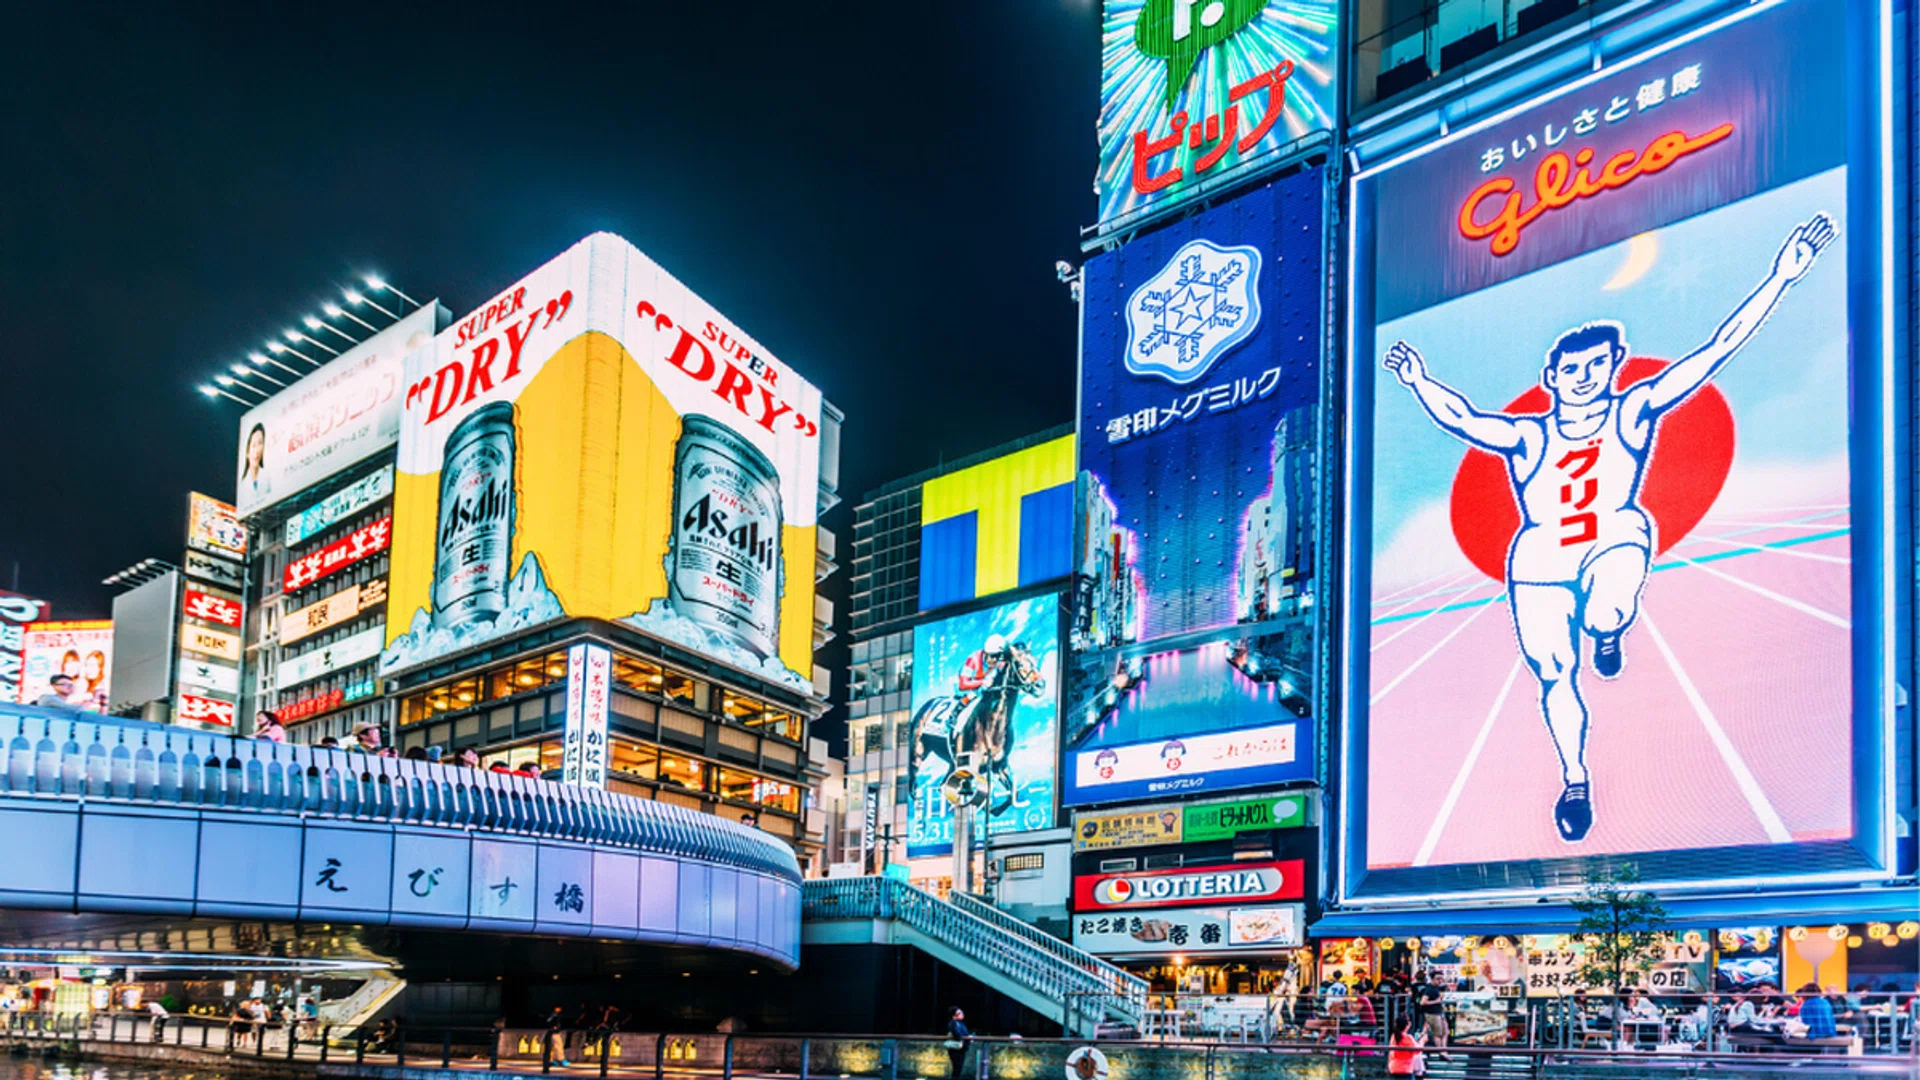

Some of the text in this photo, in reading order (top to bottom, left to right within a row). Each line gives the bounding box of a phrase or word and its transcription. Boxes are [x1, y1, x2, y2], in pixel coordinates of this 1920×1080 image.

[1132, 59, 1294, 194] ピップ
[1481, 63, 1702, 172] おいしさと健康
[454, 286, 527, 349] SUPER
[702, 320, 778, 387] SUPER
[1105, 366, 1281, 444] 雪印メグミルク
[441, 477, 507, 548] Asahi
[1554, 438, 1603, 547] グリコ
[462, 543, 481, 566] 生
[683, 493, 773, 571] Asahi
[716, 560, 742, 587] 生
[866, 791, 876, 850] TSUTAYA
[1220, 804, 1268, 828] ピタットハウス
[316, 858, 584, 914] えびす橋
[1138, 872, 1266, 898] LOTTERIA
[1080, 916, 1143, 935] たこ焼き
[1528, 950, 1576, 966] 串カツ
[1652, 971, 1686, 987] の店
